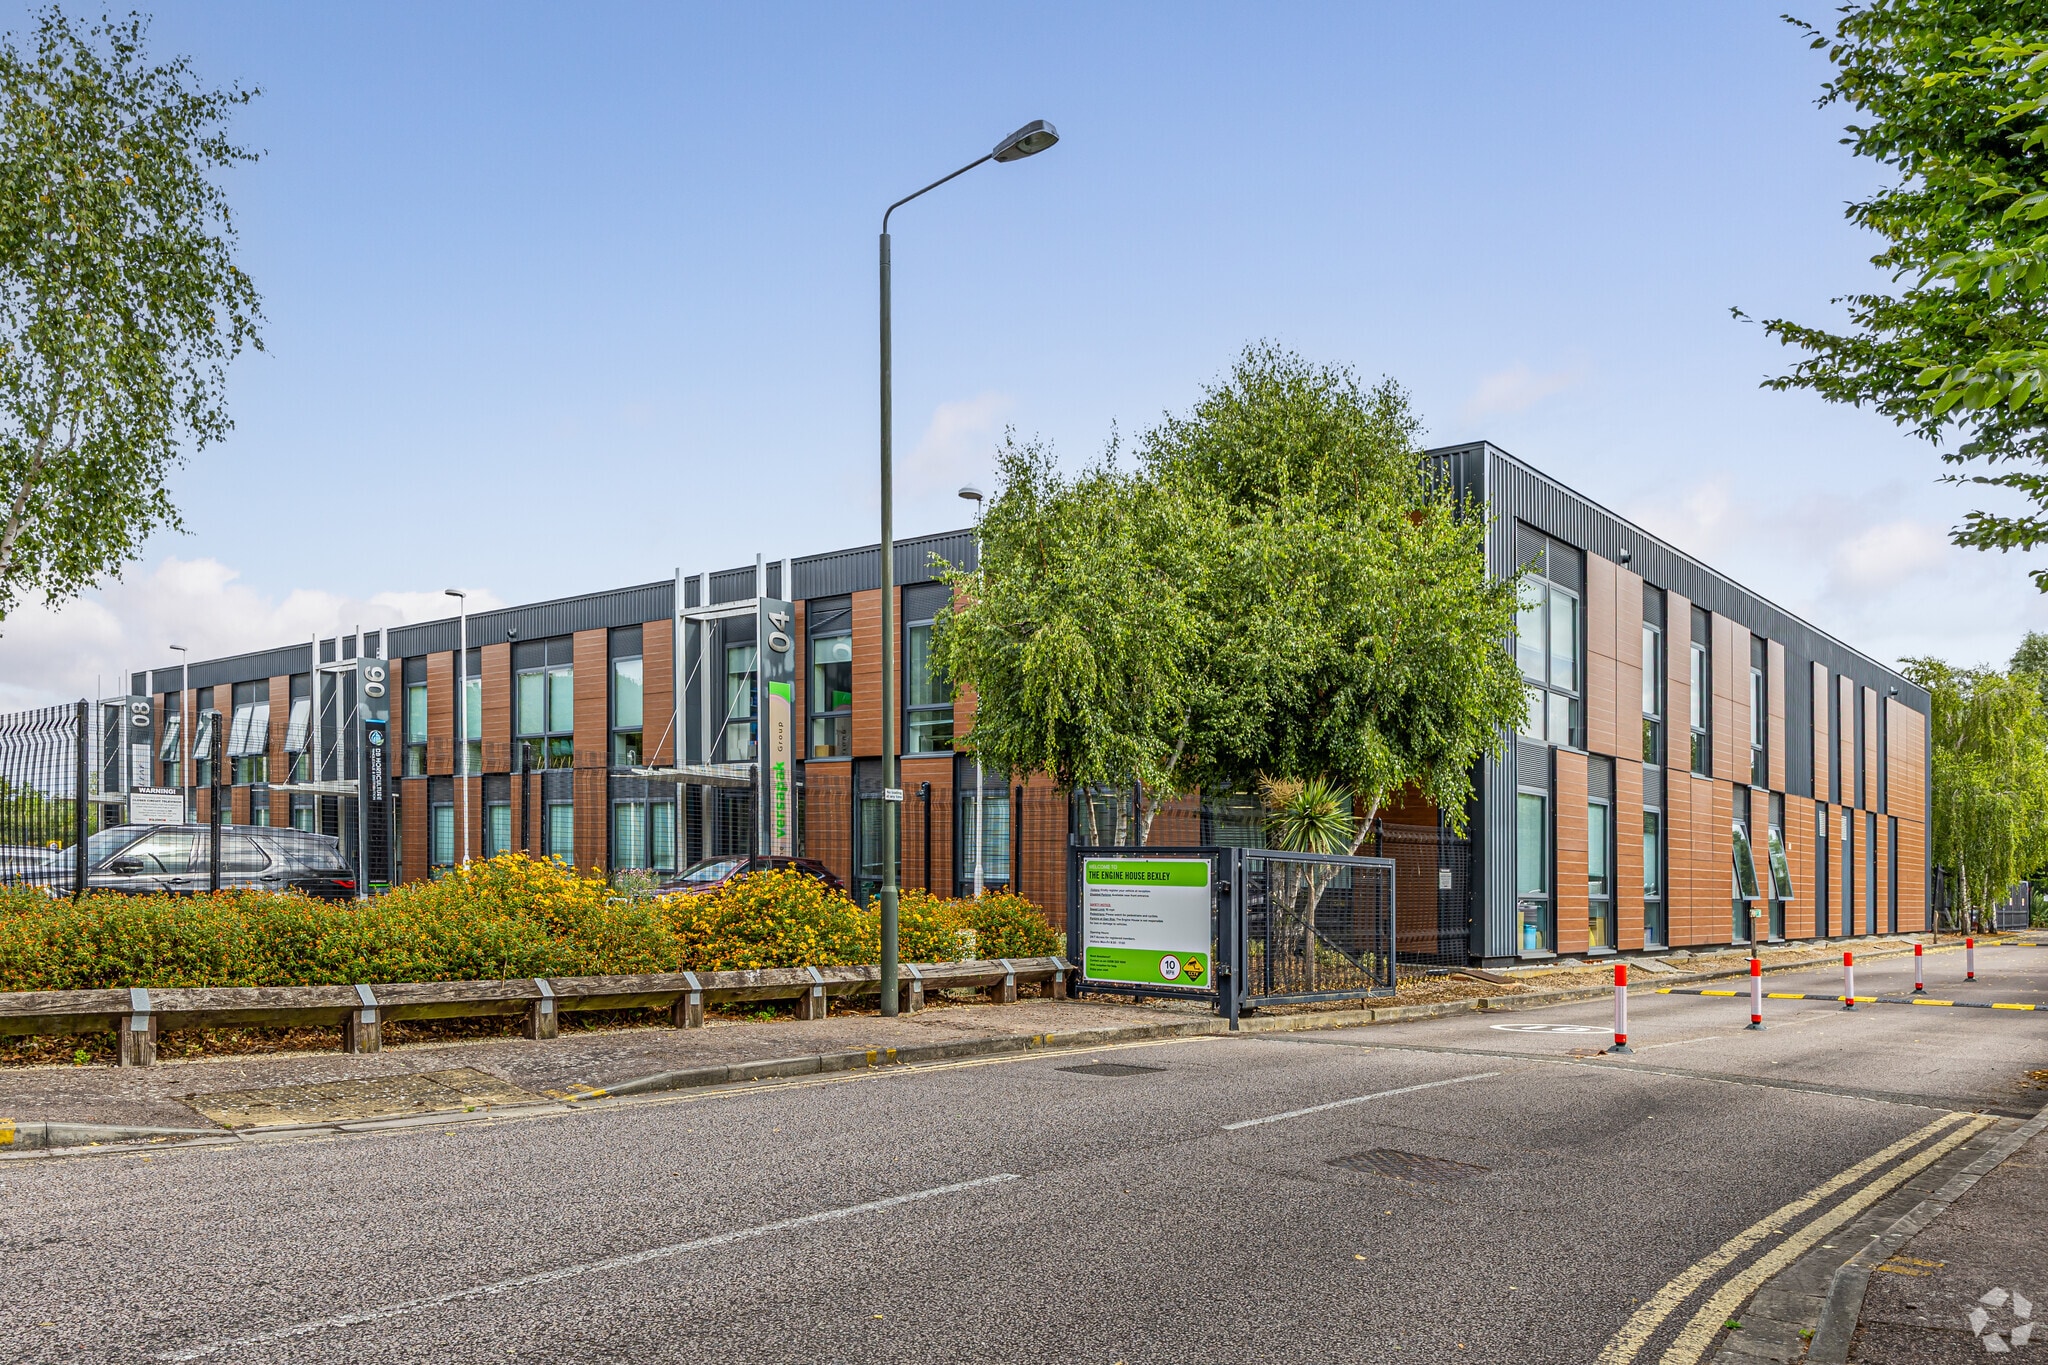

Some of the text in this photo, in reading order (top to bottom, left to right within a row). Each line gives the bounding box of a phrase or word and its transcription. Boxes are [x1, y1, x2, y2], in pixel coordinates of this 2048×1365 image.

[768, 610, 790, 654] 04
[364, 666, 386, 698] 06
[132, 702, 150, 727] 08
[376, 748, 382, 757] DB
[772, 762, 785, 839] versapak
[1089, 871, 1170, 880] THE ENGINE HOUSE BEXLEY
[1165, 960, 1175, 969] 10
